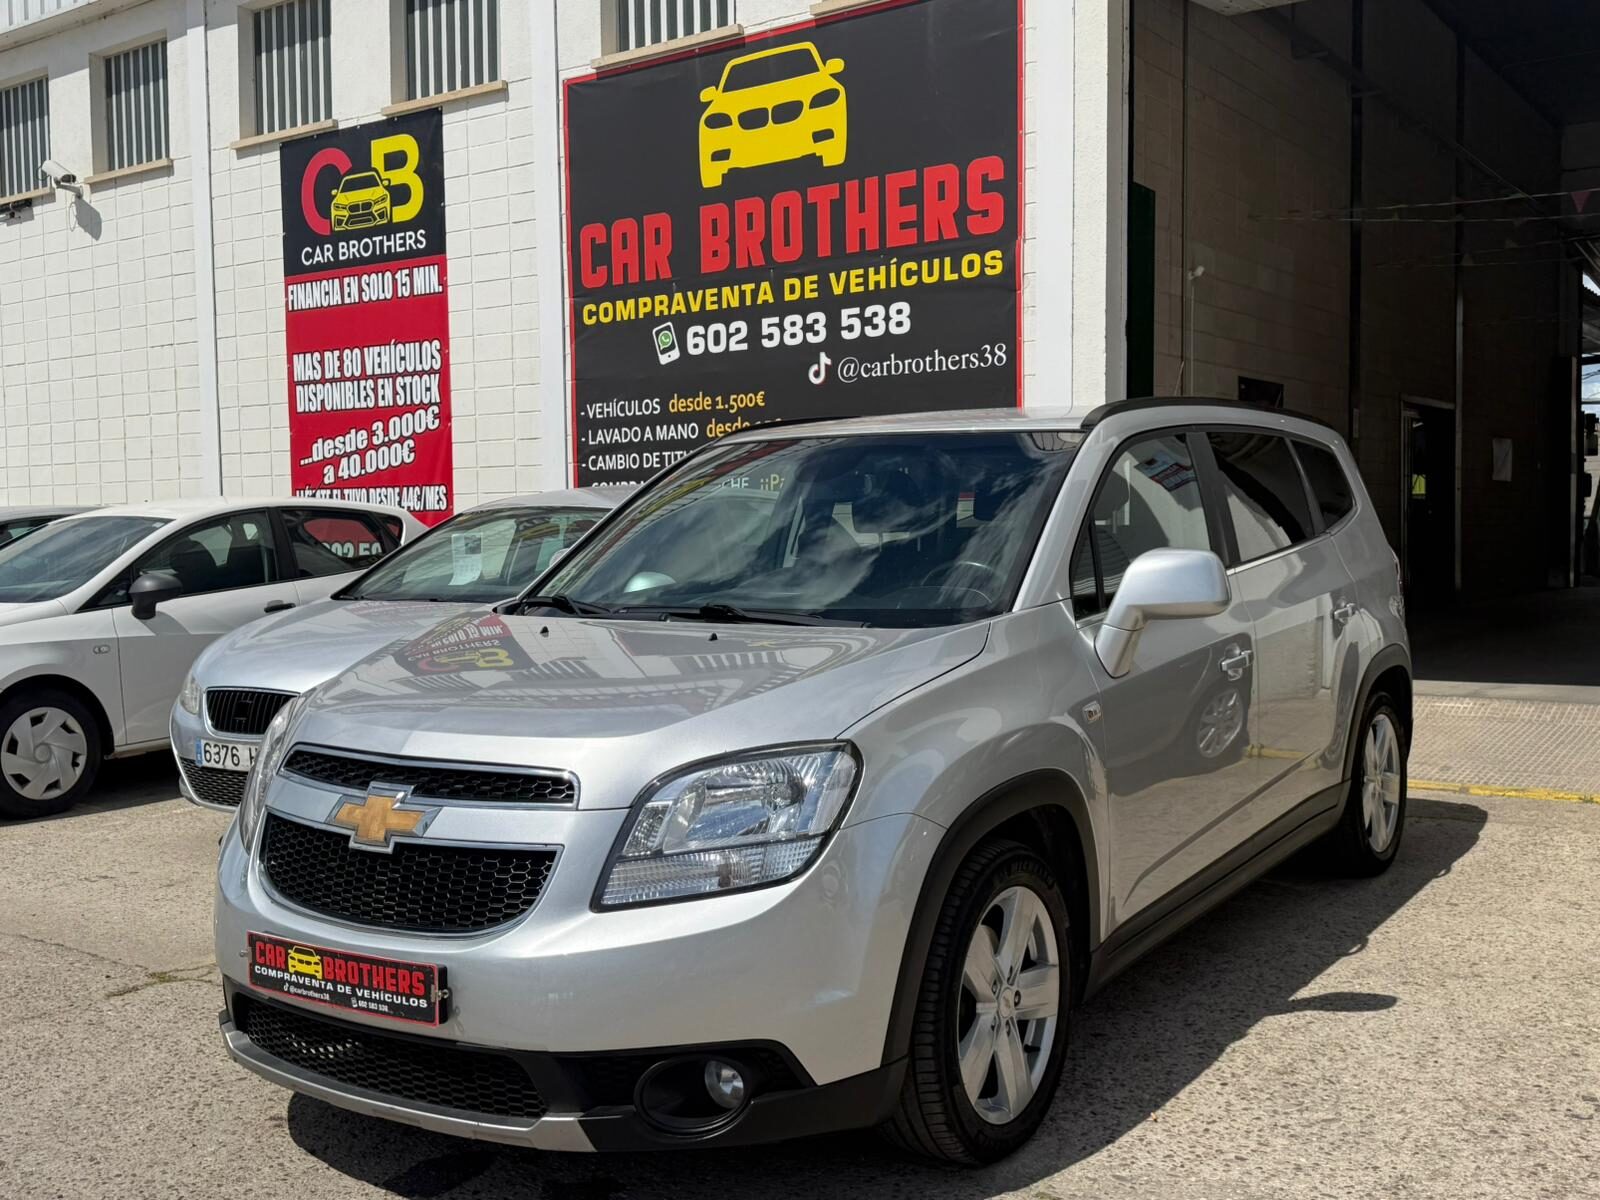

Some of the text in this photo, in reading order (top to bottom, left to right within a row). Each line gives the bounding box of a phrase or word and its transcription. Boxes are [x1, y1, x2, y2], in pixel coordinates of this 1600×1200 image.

[580, 155, 1005, 289] CAR BROTHERS
[301, 229, 427, 265] CAR BROTHERS
[287, 264, 443, 311] FINANCIA EN SOLO 15 MIN.
[582, 249, 1004, 326] COMPRAVENTA DE VEHÍCULOS
[686, 301, 912, 356] 602 583 538
[293, 338, 441, 382] MAS DE 80 VEHÍCULOS
[837, 343, 1008, 384] @carbrothers38
[295, 373, 440, 413] DISPONIBLES EN STOCK
[669, 391, 712, 414] desde
[715, 391, 766, 414] 1.500€
[371, 405, 440, 446] 3.000€
[588, 426, 641, 446] LAVADO
[643, 425, 653, 442] A
[655, 422, 699, 442] MANO
[323, 439, 415, 485] a 40.000€
[588, 453, 640, 471] CAMBIO
[643, 452, 661, 469] DE
[400, 485, 447, 511] 44€/MES
[203, 742, 240, 767] 6376
[254, 965, 428, 1009] COMPRAVENTA DE VEHÍCULOS
[255, 940, 426, 997] CAR BROTHERS
